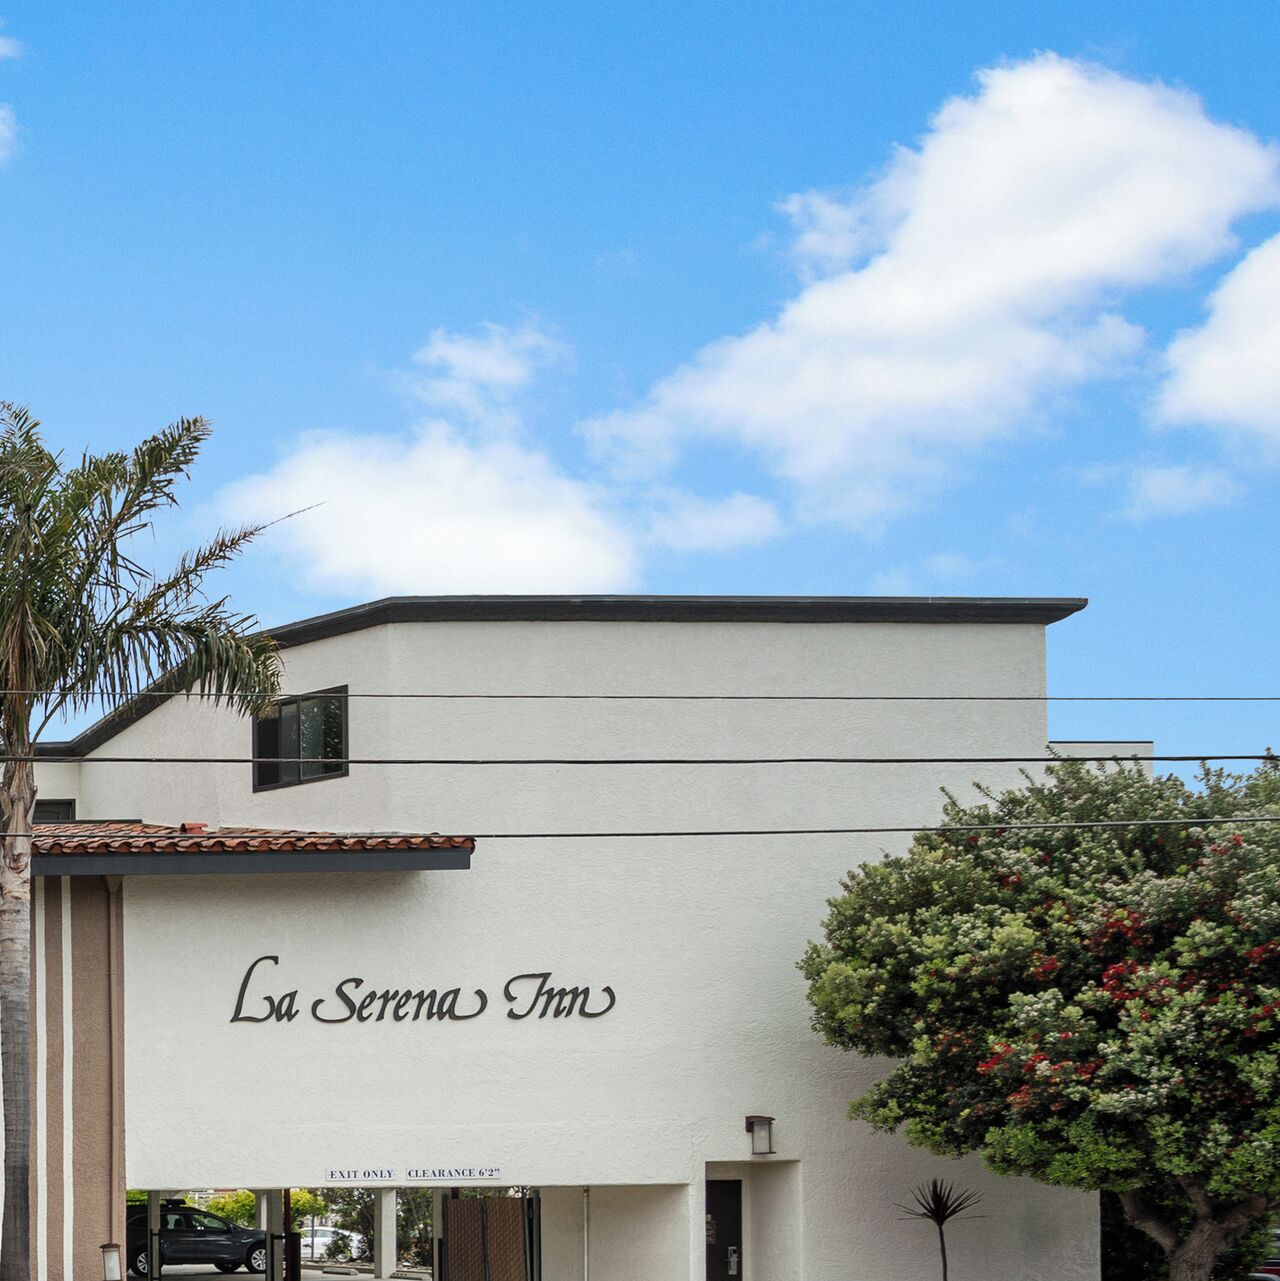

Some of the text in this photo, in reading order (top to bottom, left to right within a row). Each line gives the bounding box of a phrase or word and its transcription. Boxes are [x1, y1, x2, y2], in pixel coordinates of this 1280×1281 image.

[229, 955, 617, 1024] La Serena Inn
[329, 1169, 395, 1179] EXIT ONLY
[407, 1168, 476, 1178] CLEARANCE
